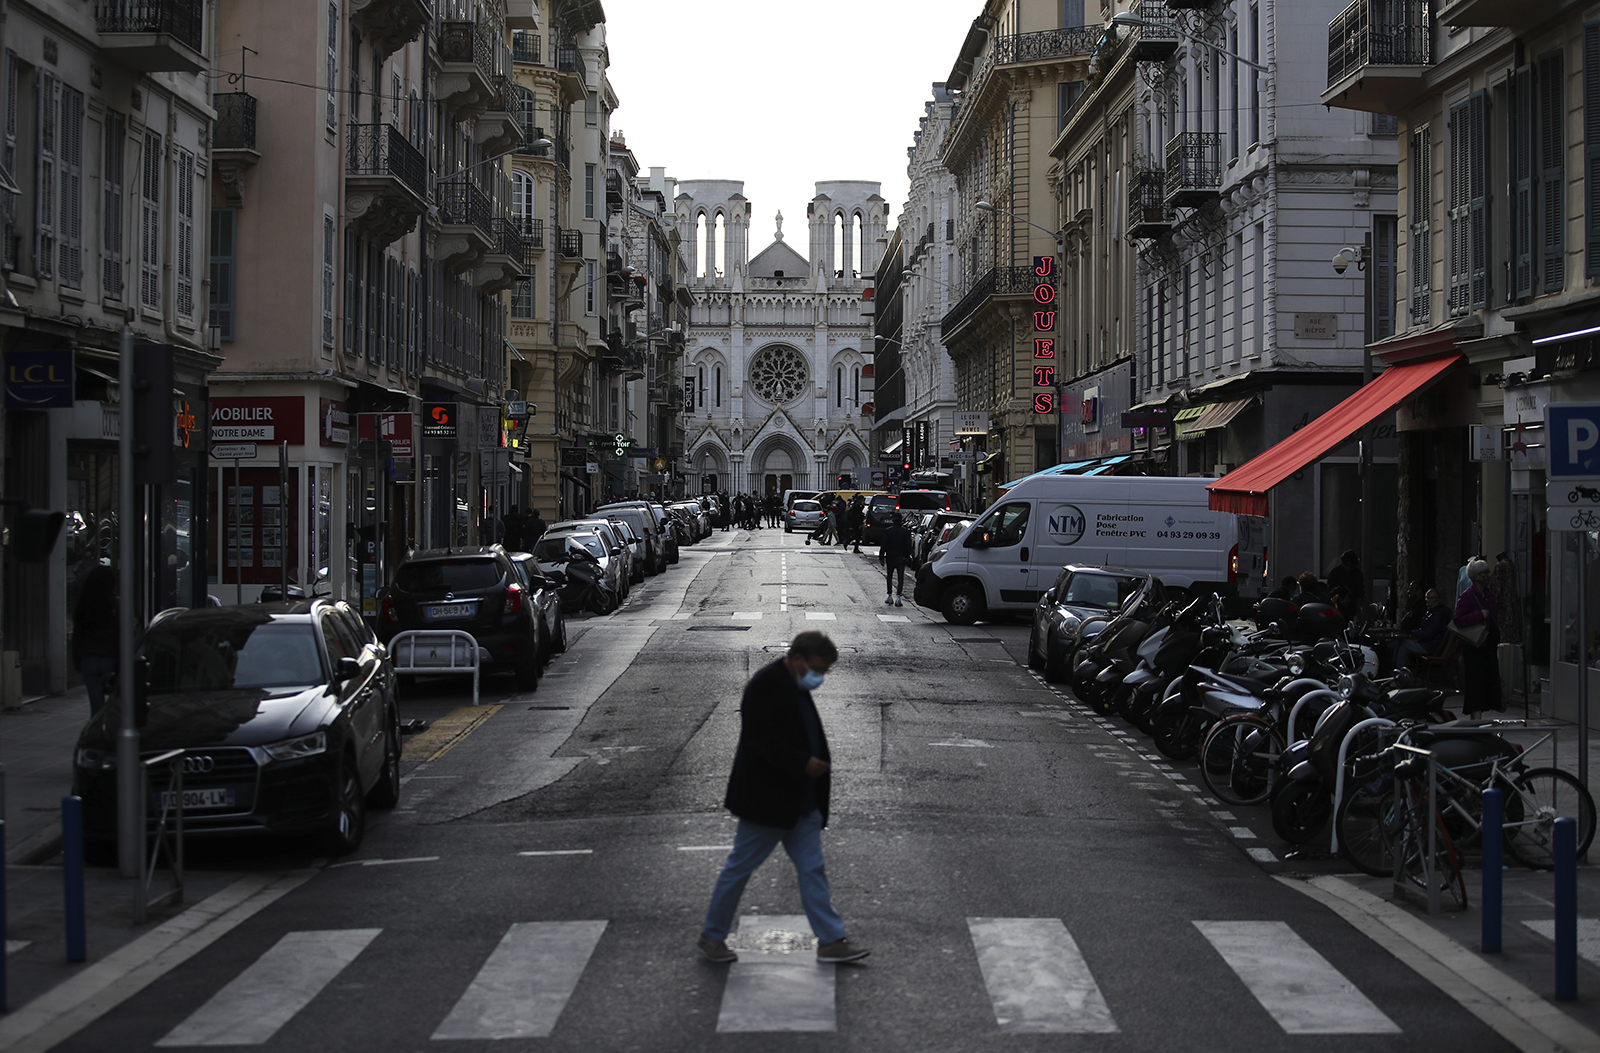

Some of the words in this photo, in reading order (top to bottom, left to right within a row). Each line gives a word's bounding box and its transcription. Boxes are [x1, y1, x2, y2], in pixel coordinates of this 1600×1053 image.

[1033, 256, 1055, 413] JOUETS
[10, 365, 64, 383] LCL
[685, 381, 694, 407] fnac
[212, 429, 239, 437] NOTRE
[241, 429, 265, 437] DAME
[1567, 418, 1599, 464] P
[888, 467, 895, 477] P
[1096, 514, 1144, 522] Fabrication
[1048, 515, 1083, 533] NTM
[1096, 521, 1117, 529] Pose
[1096, 529, 1128, 538] Fenêtre
[1130, 530, 1147, 538] PVC
[1157, 530, 1168, 538] 04
[1183, 531, 1194, 539] 29
